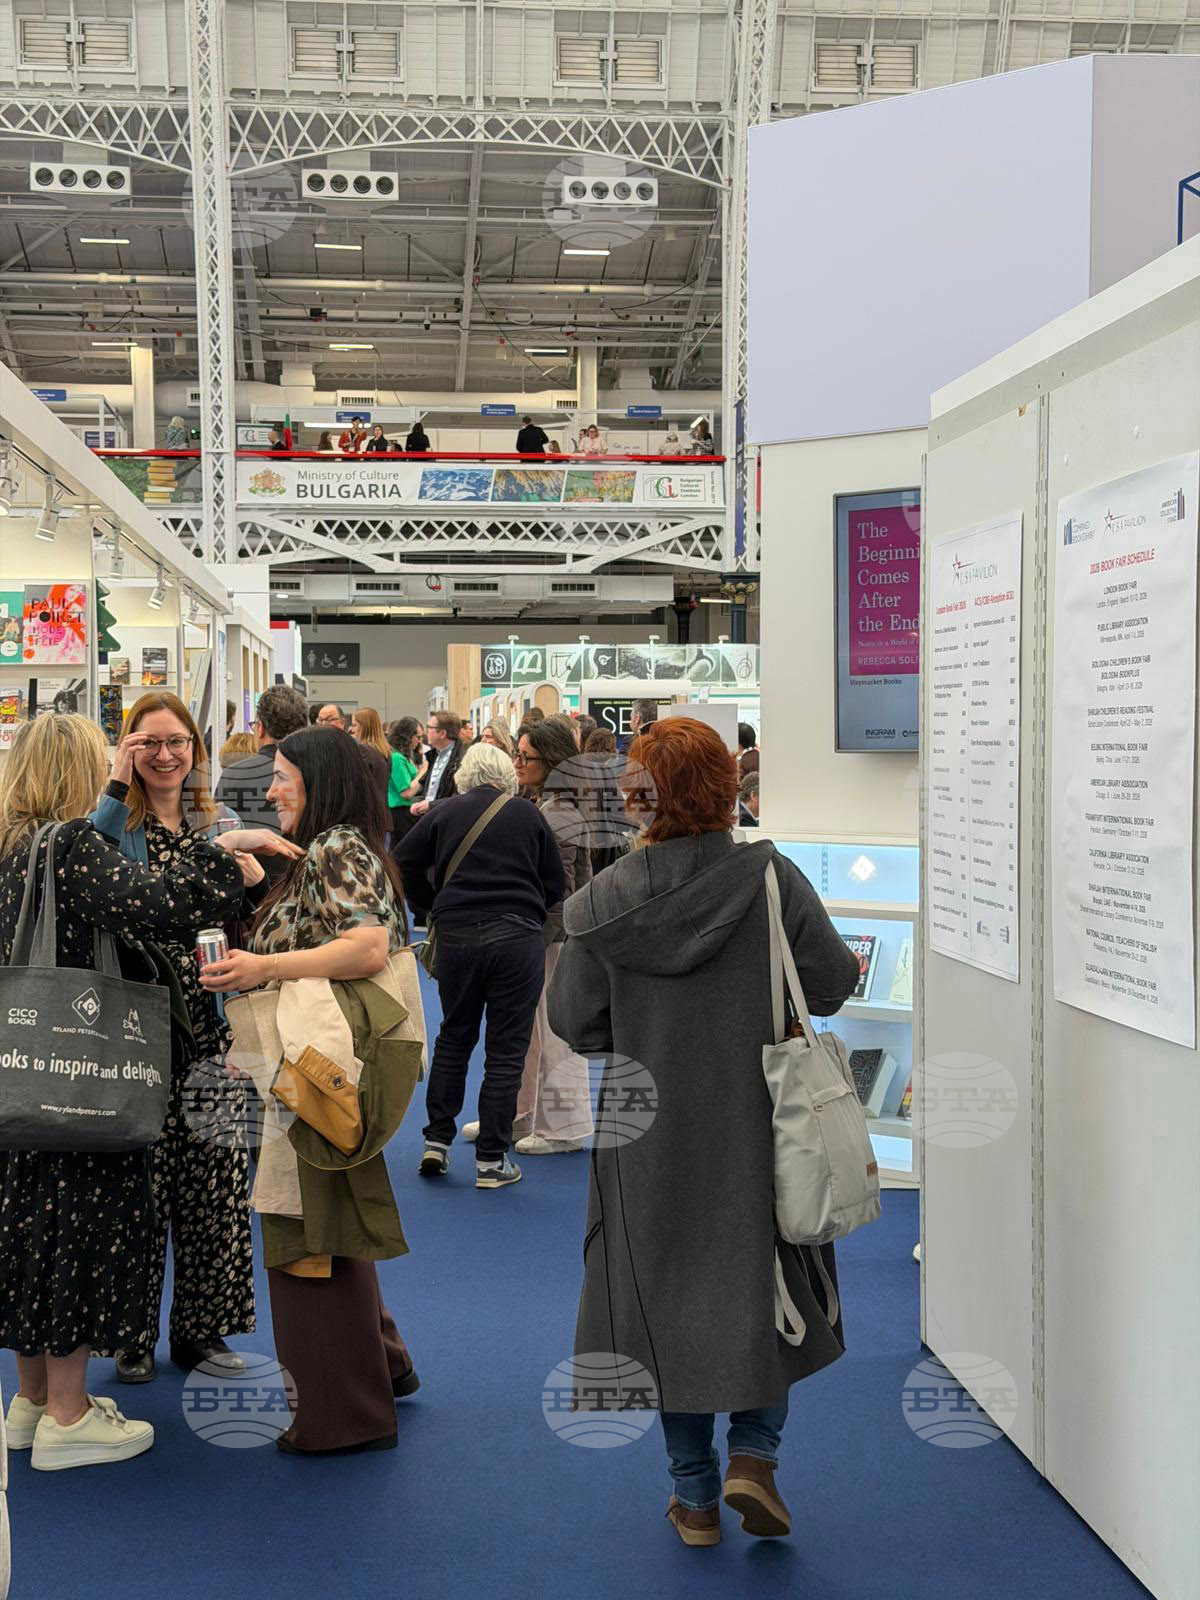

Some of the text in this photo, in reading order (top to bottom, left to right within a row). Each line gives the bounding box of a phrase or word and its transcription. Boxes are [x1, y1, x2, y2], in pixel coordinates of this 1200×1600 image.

[298, 470, 399, 481] Ministry of Culture
[297, 484, 401, 498] BULGARIA
[857, 522, 888, 539] The
[1100, 558, 1116, 572] BOOK
[1116, 555, 1127, 569] FAIR
[1127, 548, 1155, 566] SCHEDULE
[857, 569, 910, 585] Comes
[1118, 582, 1128, 591] BOOK
[1129, 581, 1137, 590] FAIR
[31, 598, 68, 610] PAUL
[858, 592, 901, 609] After
[29, 611, 81, 623] POIRET
[858, 616, 883, 632] the
[890, 614, 920, 631] End
[1110, 620, 1124, 630] LIBRARY
[1125, 617, 1148, 628] ASSOCIATION
[858, 656, 895, 665] REBECCA
[1127, 743, 1138, 751] BOOK
[1139, 743, 1148, 751] FAIR
[1121, 780, 1148, 789] ASSOCIATION
[1103, 815, 1133, 825] INTERNATIONAL
[1134, 817, 1145, 825] BOOK
[1146, 818, 1154, 826] FAIR
[1108, 851, 1125, 860] LIBRARY
[1126, 853, 1149, 864] ASSOCIATION
[1132, 890, 1143, 900] BOOK
[1143, 892, 1151, 902] FAIR
[1136, 977, 1148, 988] BOOK
[1148, 981, 1157, 991] FAIR
[8, 1008, 38, 1018] CICO
[8, 1018, 36, 1026] BOOKS
[52, 1026, 76, 1034] RYLAND
[33, 1057, 44, 1071] to
[50, 1052, 99, 1080] inspire
[100, 1064, 118, 1079] and
[40, 1103, 116, 1117] www.rylandpeters.com
